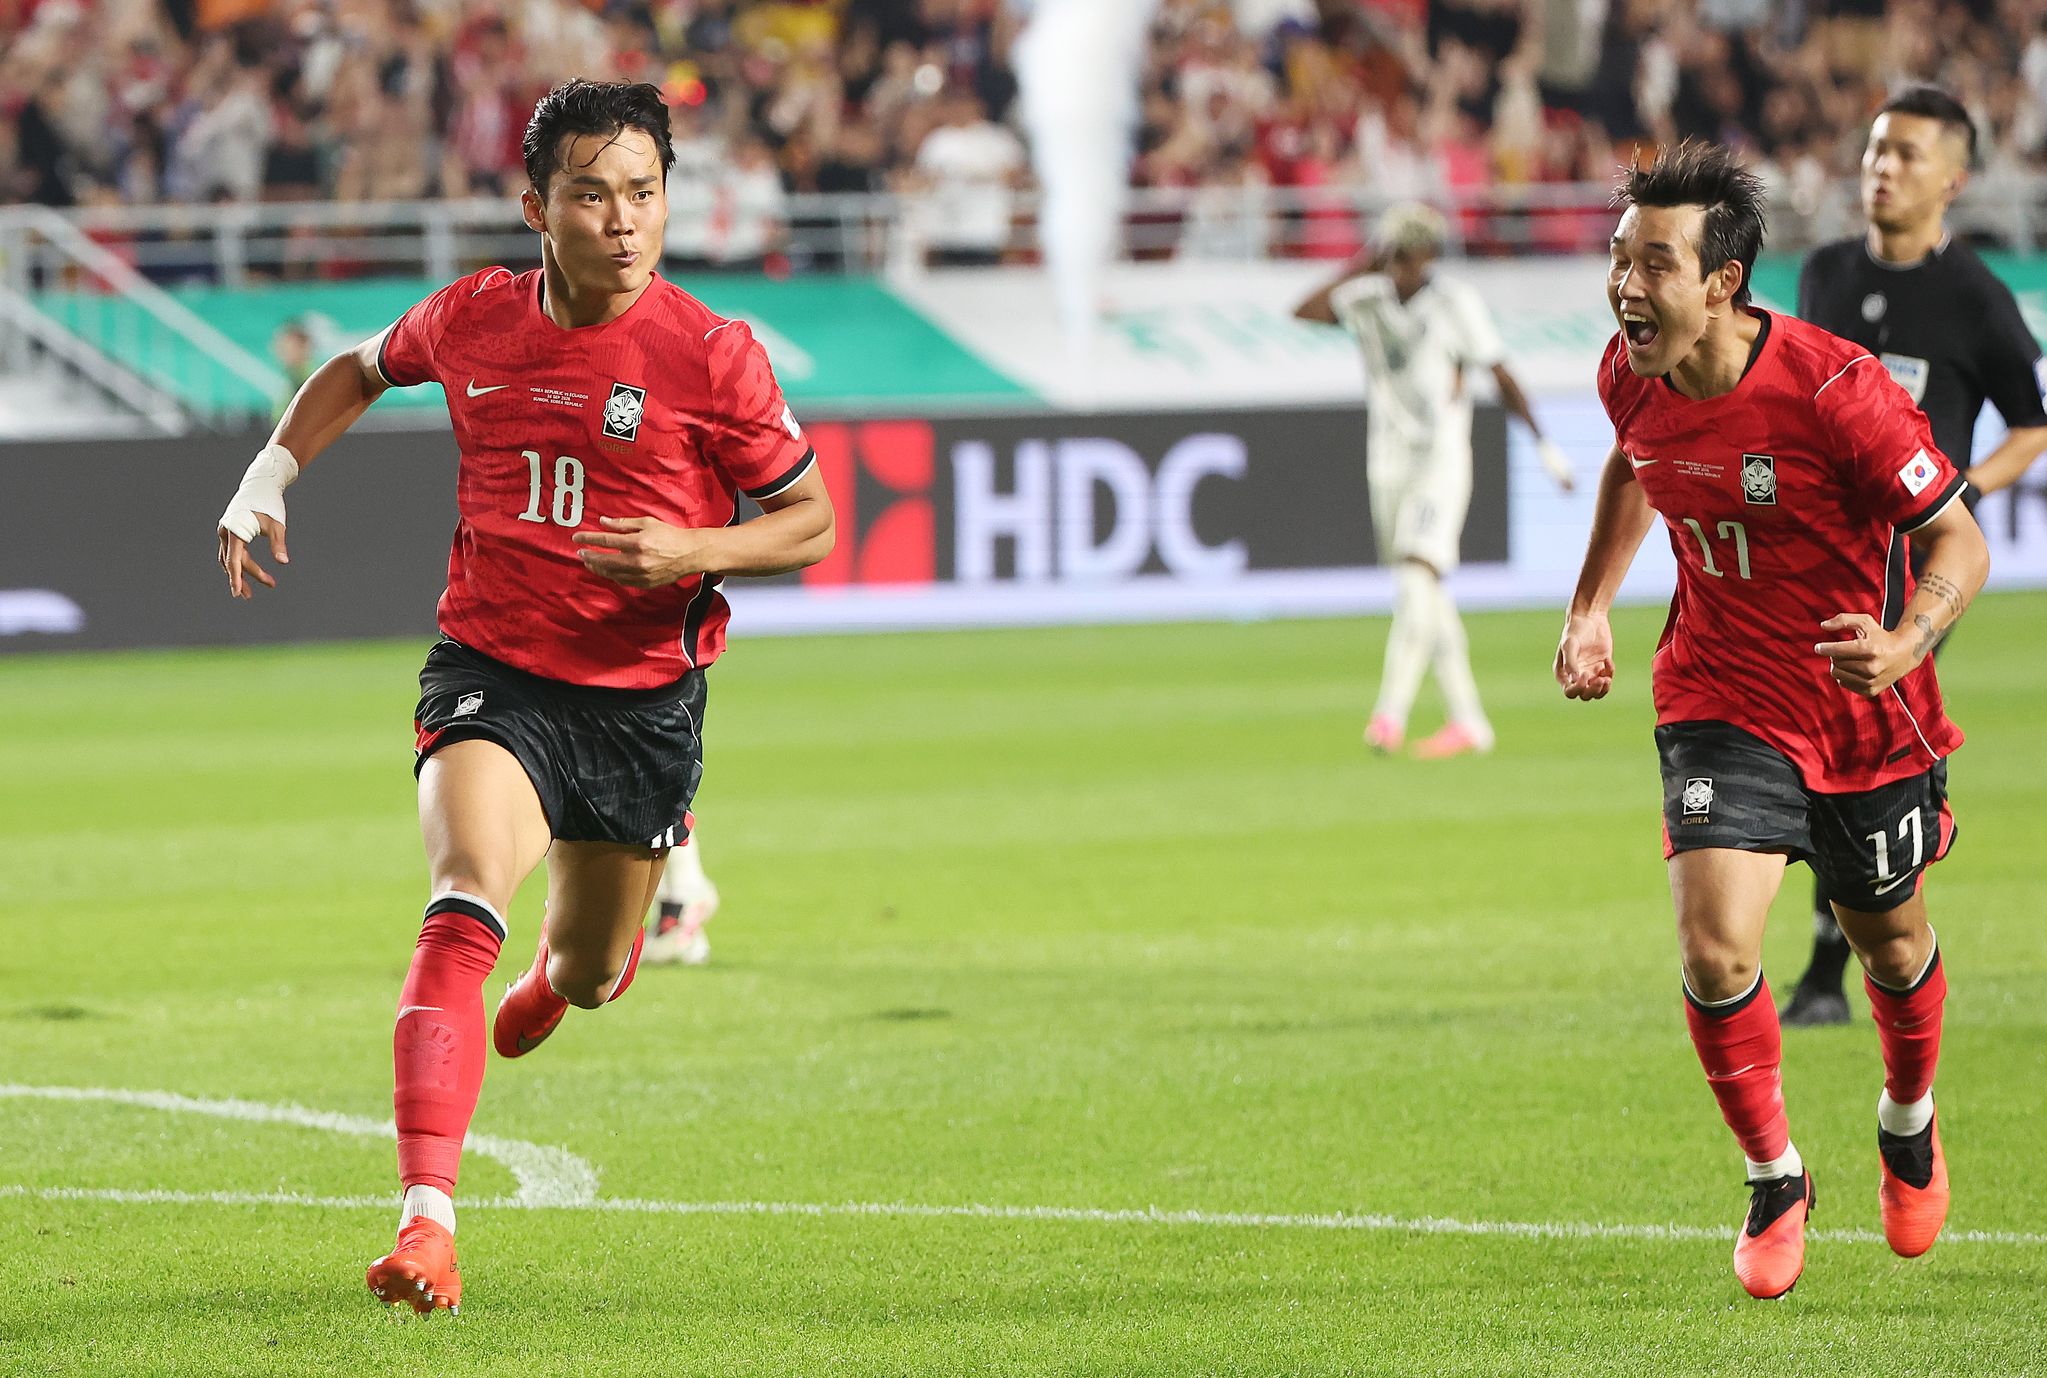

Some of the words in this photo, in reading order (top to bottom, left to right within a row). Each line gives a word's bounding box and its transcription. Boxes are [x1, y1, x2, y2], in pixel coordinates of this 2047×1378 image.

[598, 440, 634, 455] KOREA
[518, 450, 585, 528] 18
[951, 434, 1249, 580] HDC
[1682, 518, 1752, 579] 17
[1681, 816, 1710, 825] KOREA
[1865, 805, 1924, 885] 17
